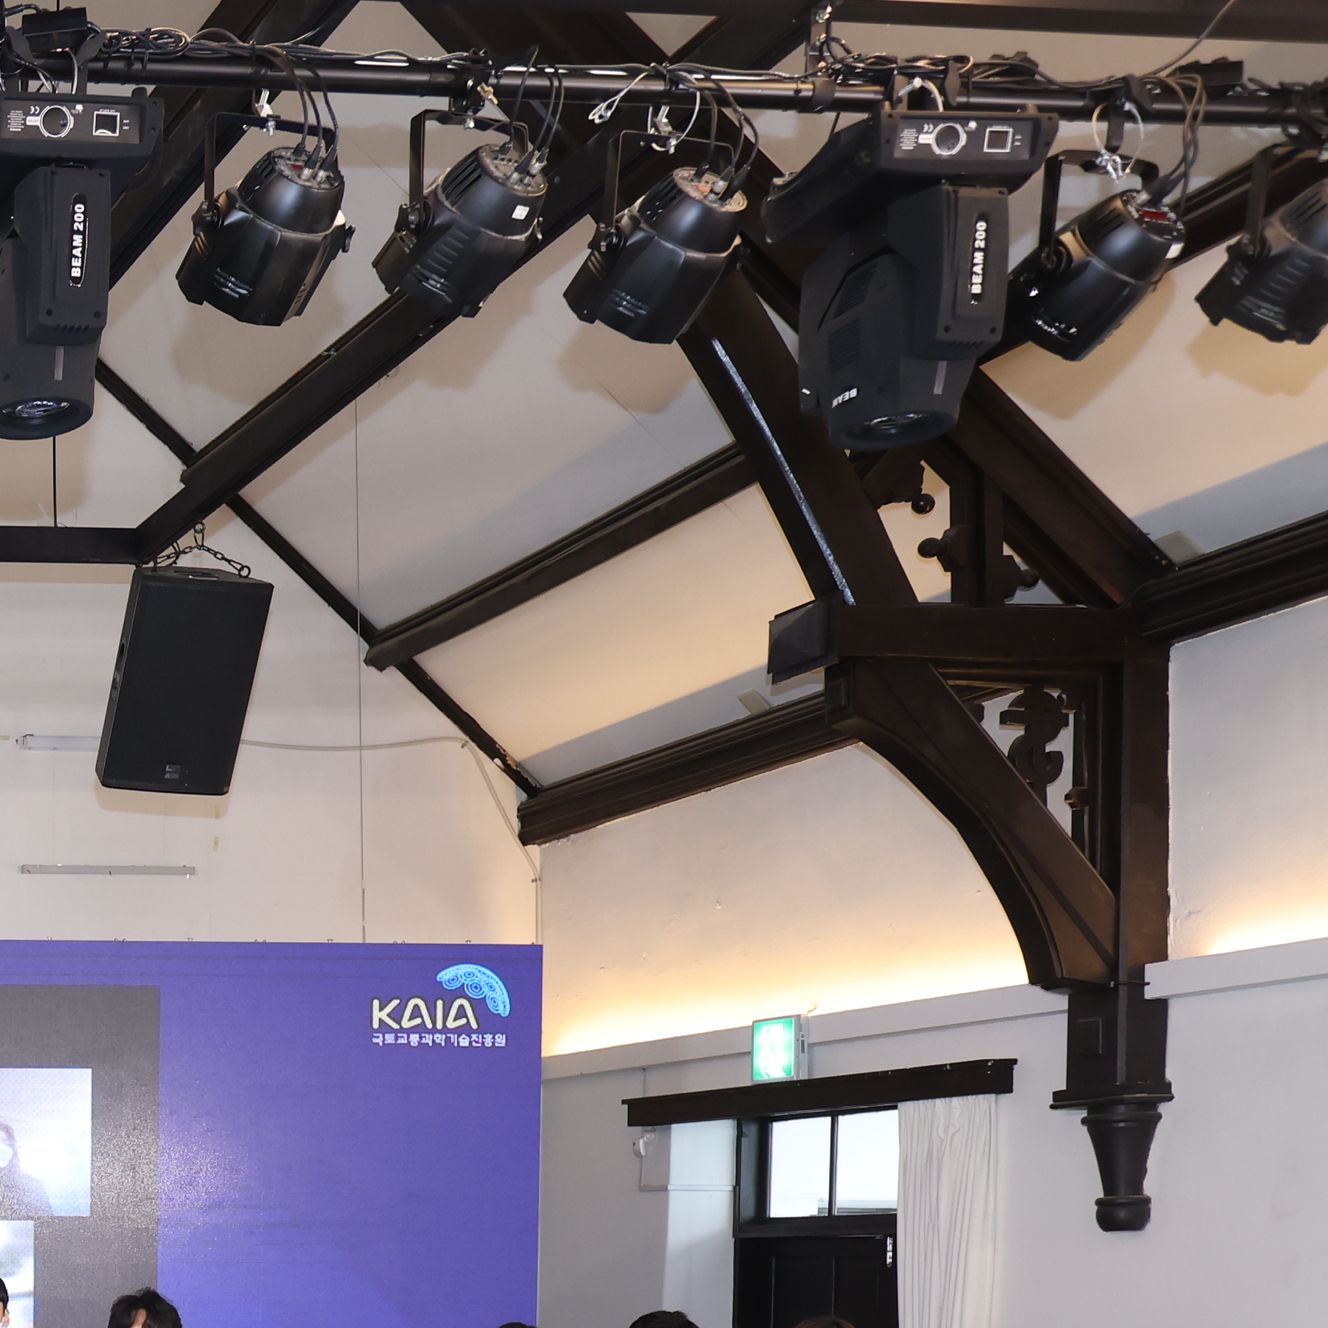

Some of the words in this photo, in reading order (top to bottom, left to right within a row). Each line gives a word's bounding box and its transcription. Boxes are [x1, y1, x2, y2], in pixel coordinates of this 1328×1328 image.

[73, 204, 85, 231] 200
[975, 221, 987, 248] 200
[71, 235, 83, 277] BEAM
[971, 251, 985, 294] BEAM
[372, 997, 478, 1030] KAIA
[372, 1033, 507, 1047] 국토교통과학기술진흥원
